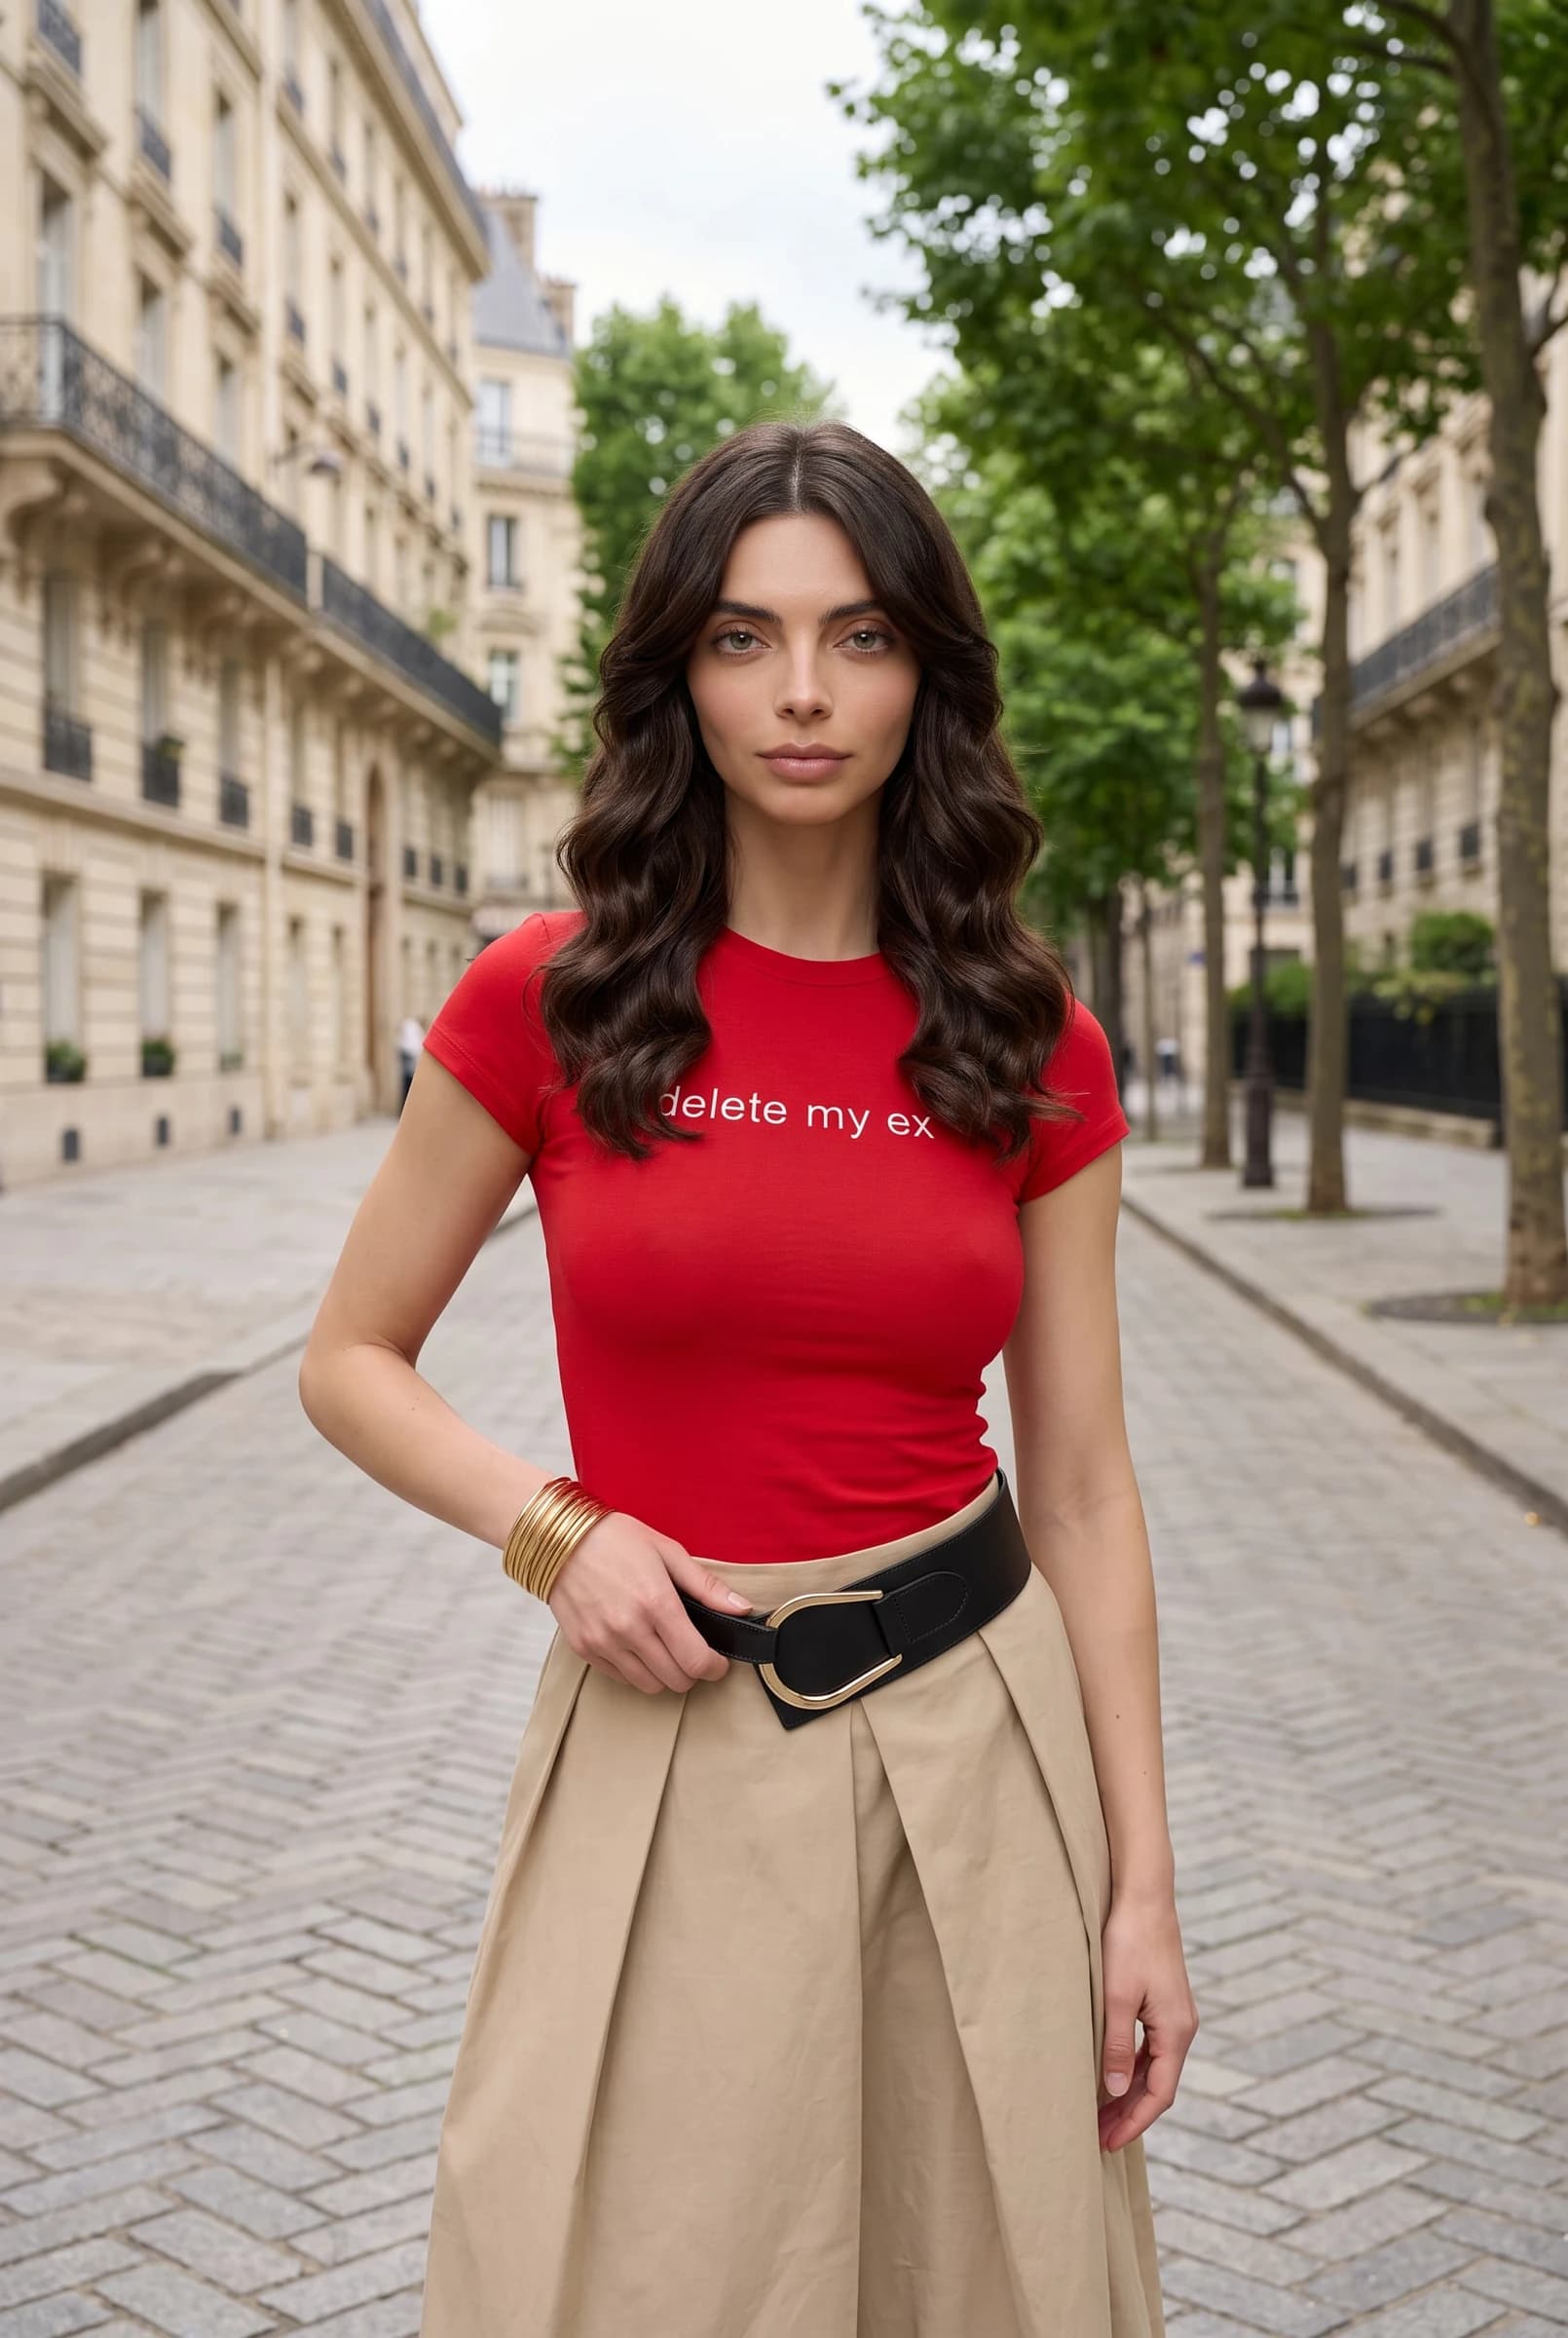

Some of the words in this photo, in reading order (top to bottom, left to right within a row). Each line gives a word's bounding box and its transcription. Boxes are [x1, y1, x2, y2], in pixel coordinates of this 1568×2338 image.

[659, 1086, 787, 1124] delete
[807, 1104, 870, 1139] my
[886, 1112, 935, 1139] ex
